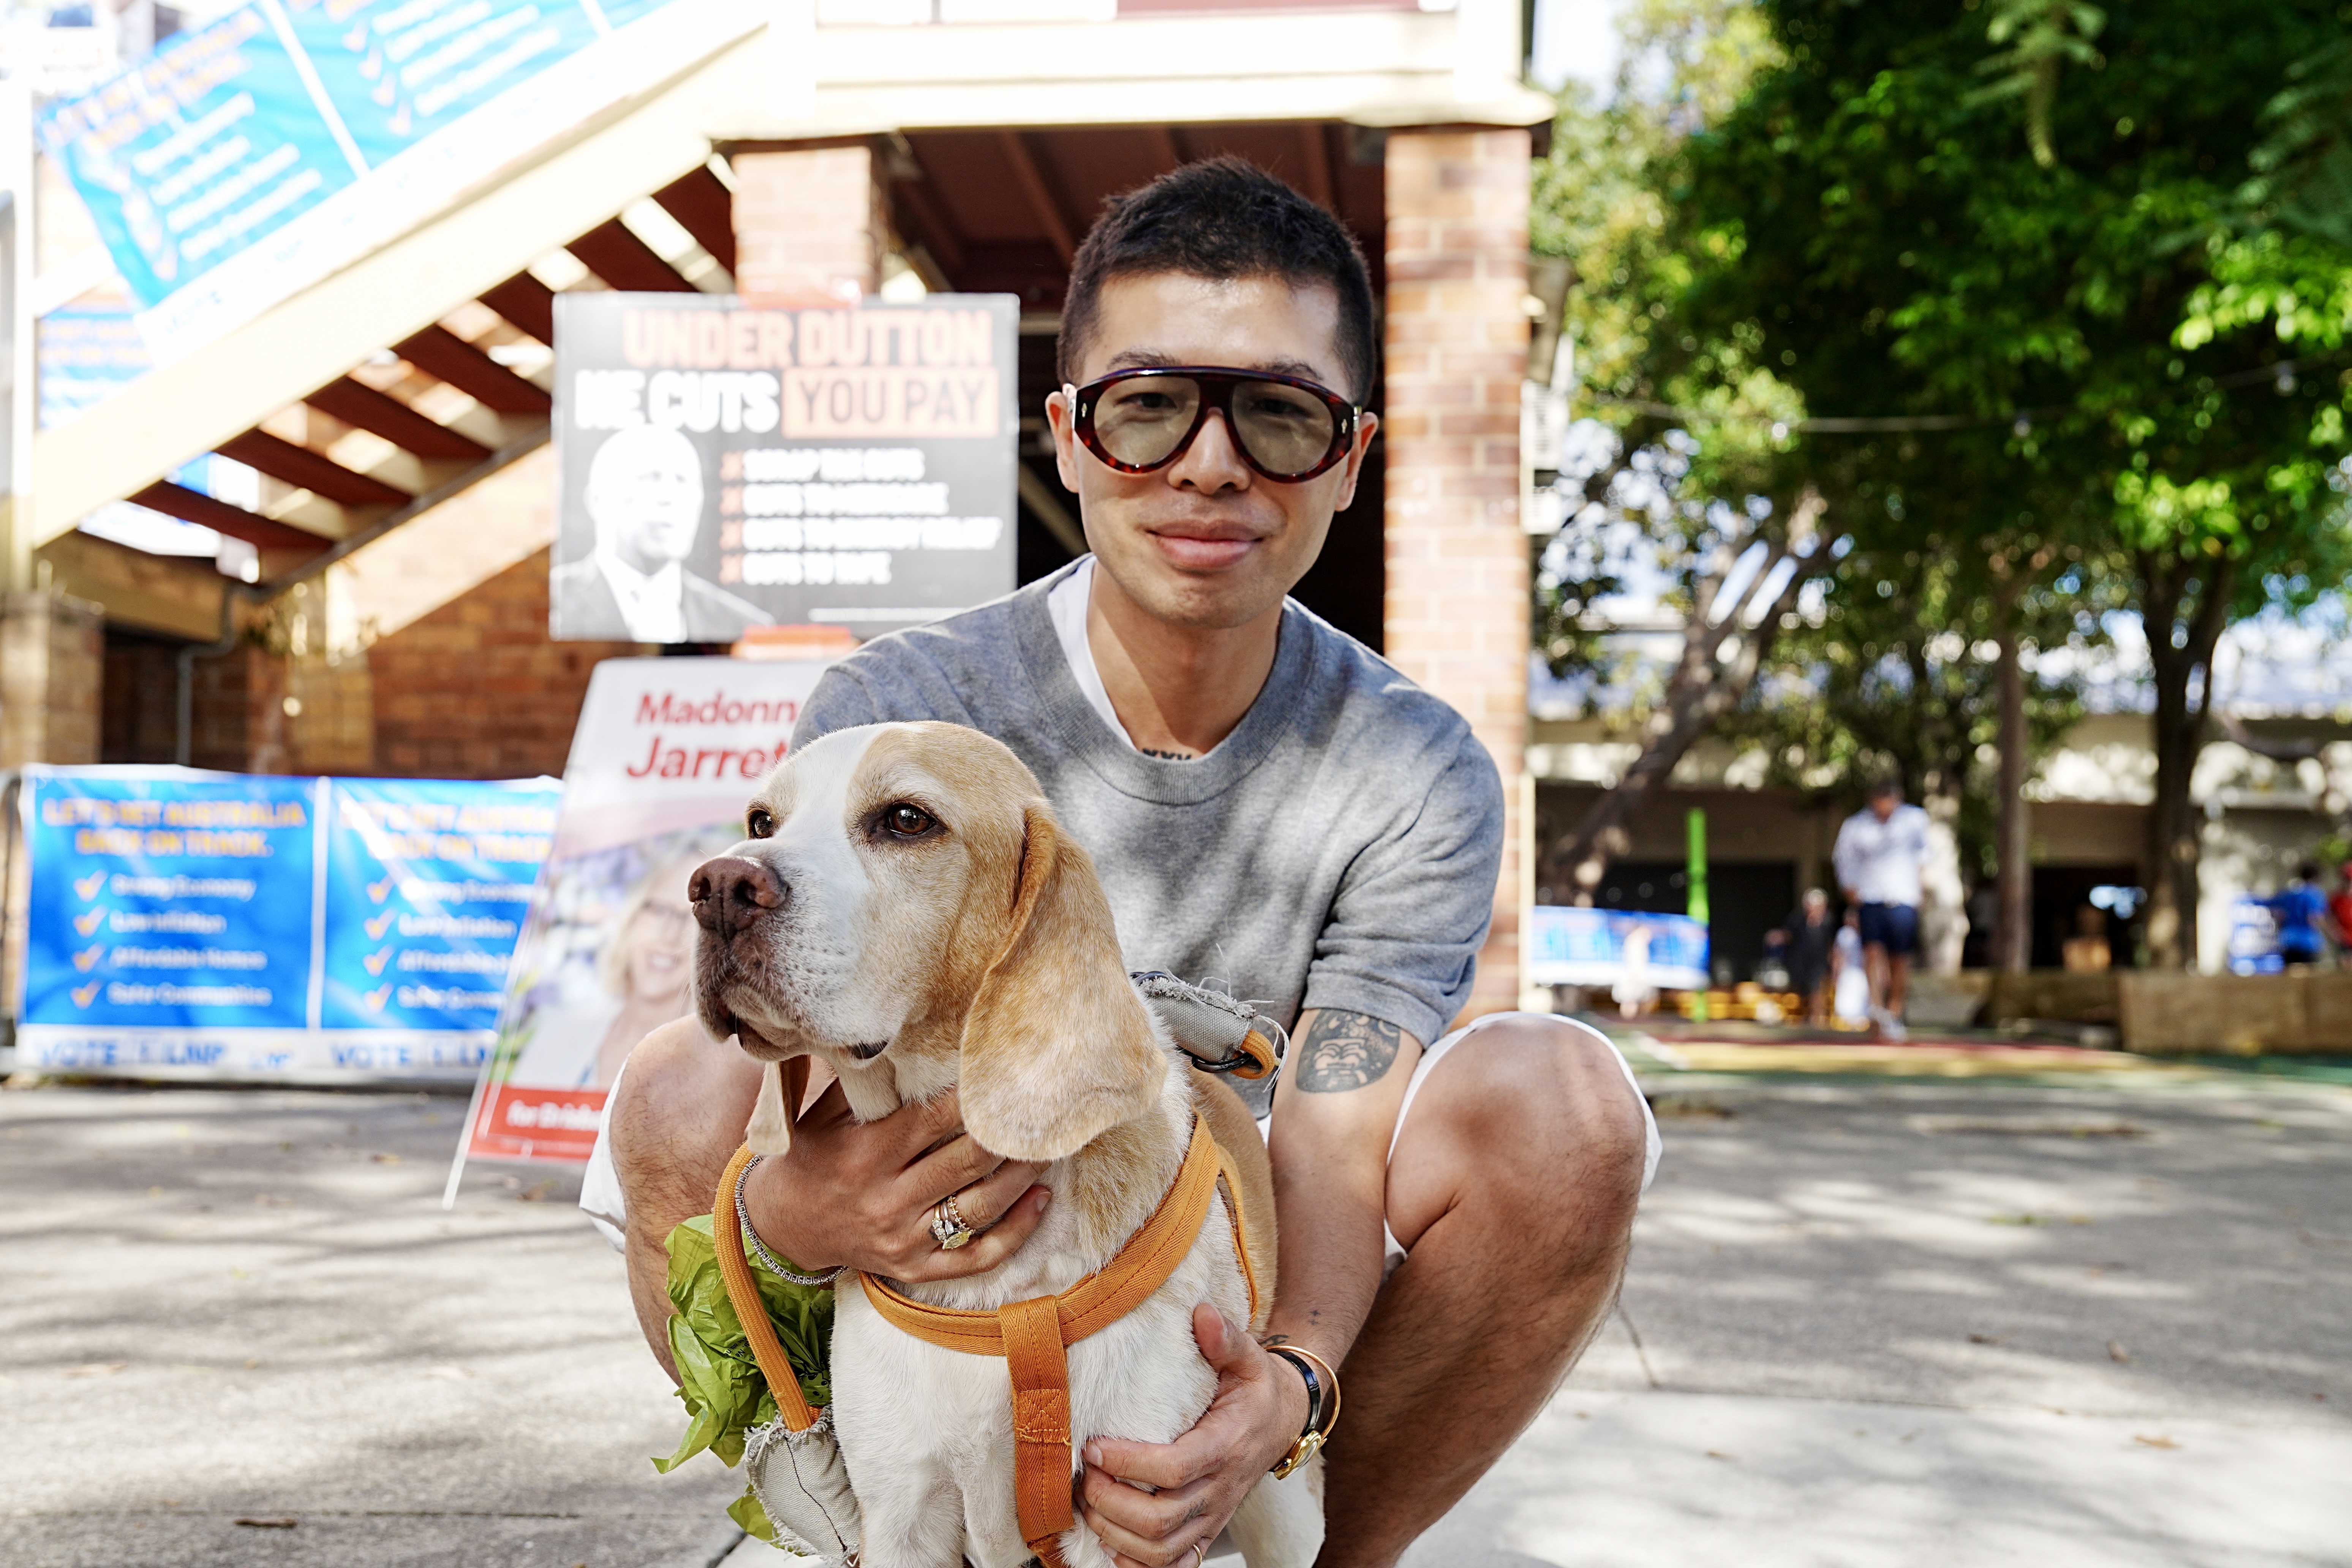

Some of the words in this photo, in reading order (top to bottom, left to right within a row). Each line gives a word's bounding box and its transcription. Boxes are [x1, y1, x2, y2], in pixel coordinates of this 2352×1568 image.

[623, 309, 794, 368] UNDER
[797, 310, 993, 366] DUTTON
[650, 370, 779, 432] CUTS
[799, 379, 887, 424] YOU
[903, 379, 985, 424] PAY
